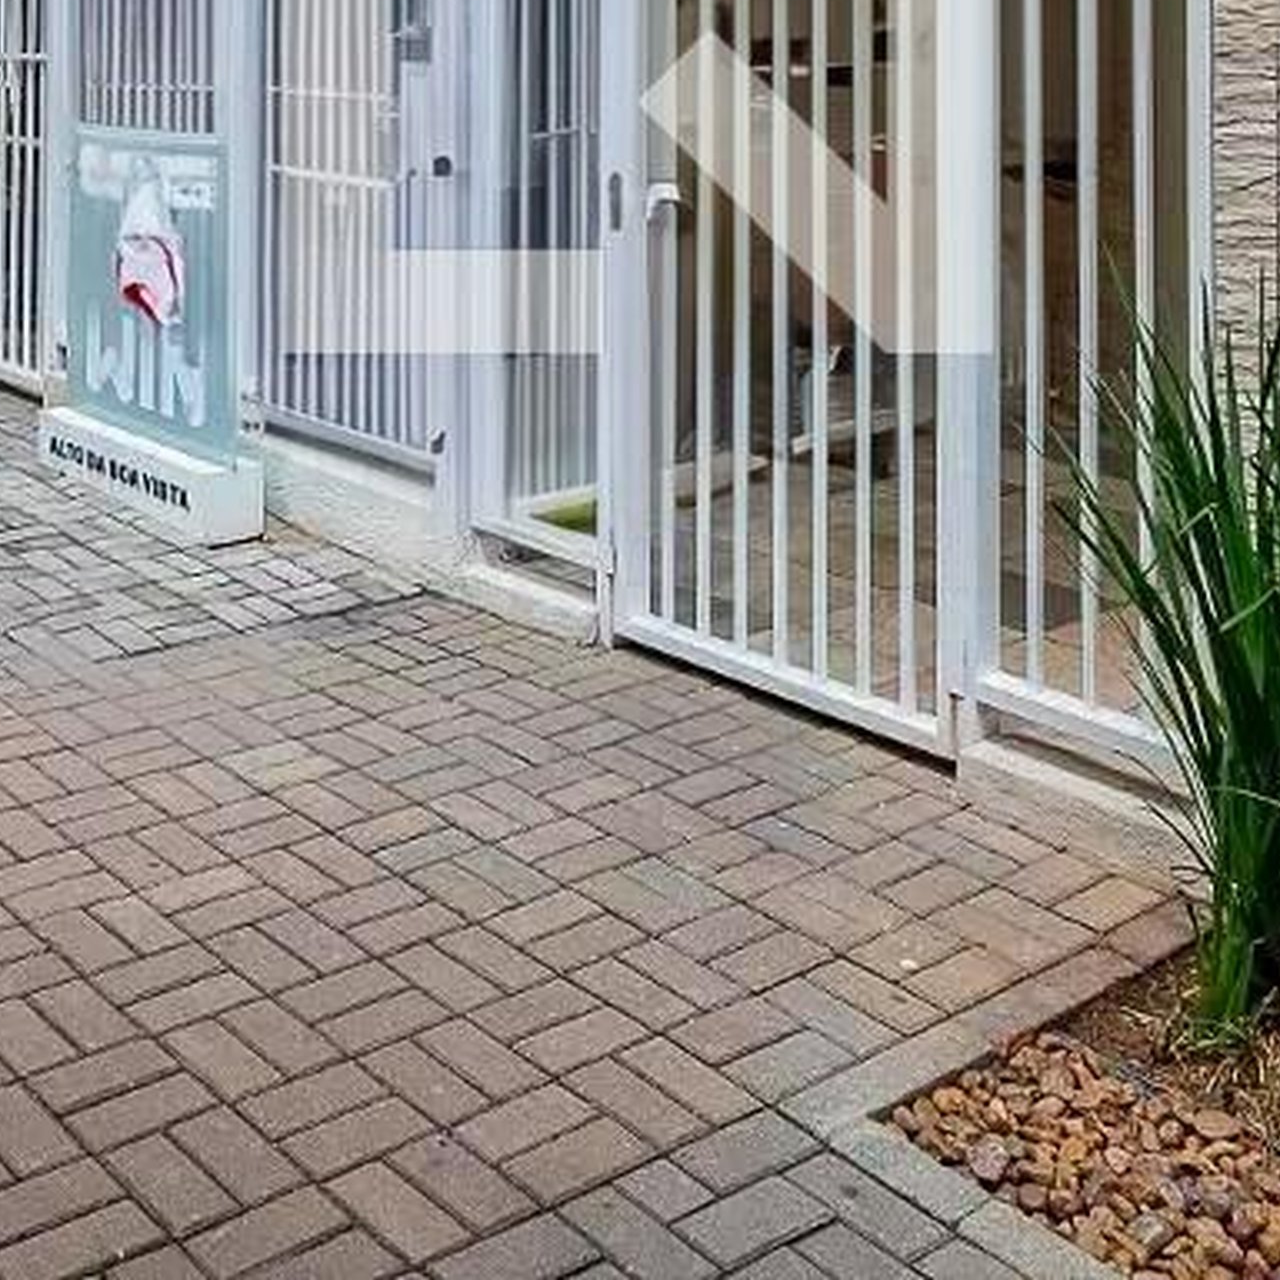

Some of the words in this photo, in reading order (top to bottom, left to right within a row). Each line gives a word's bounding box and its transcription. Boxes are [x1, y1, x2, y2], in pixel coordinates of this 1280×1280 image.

[86, 302, 205, 428] WIN
[49, 435, 84, 466] ALTO
[86, 448, 107, 476] DA
[142, 471, 191, 514] VISTA
